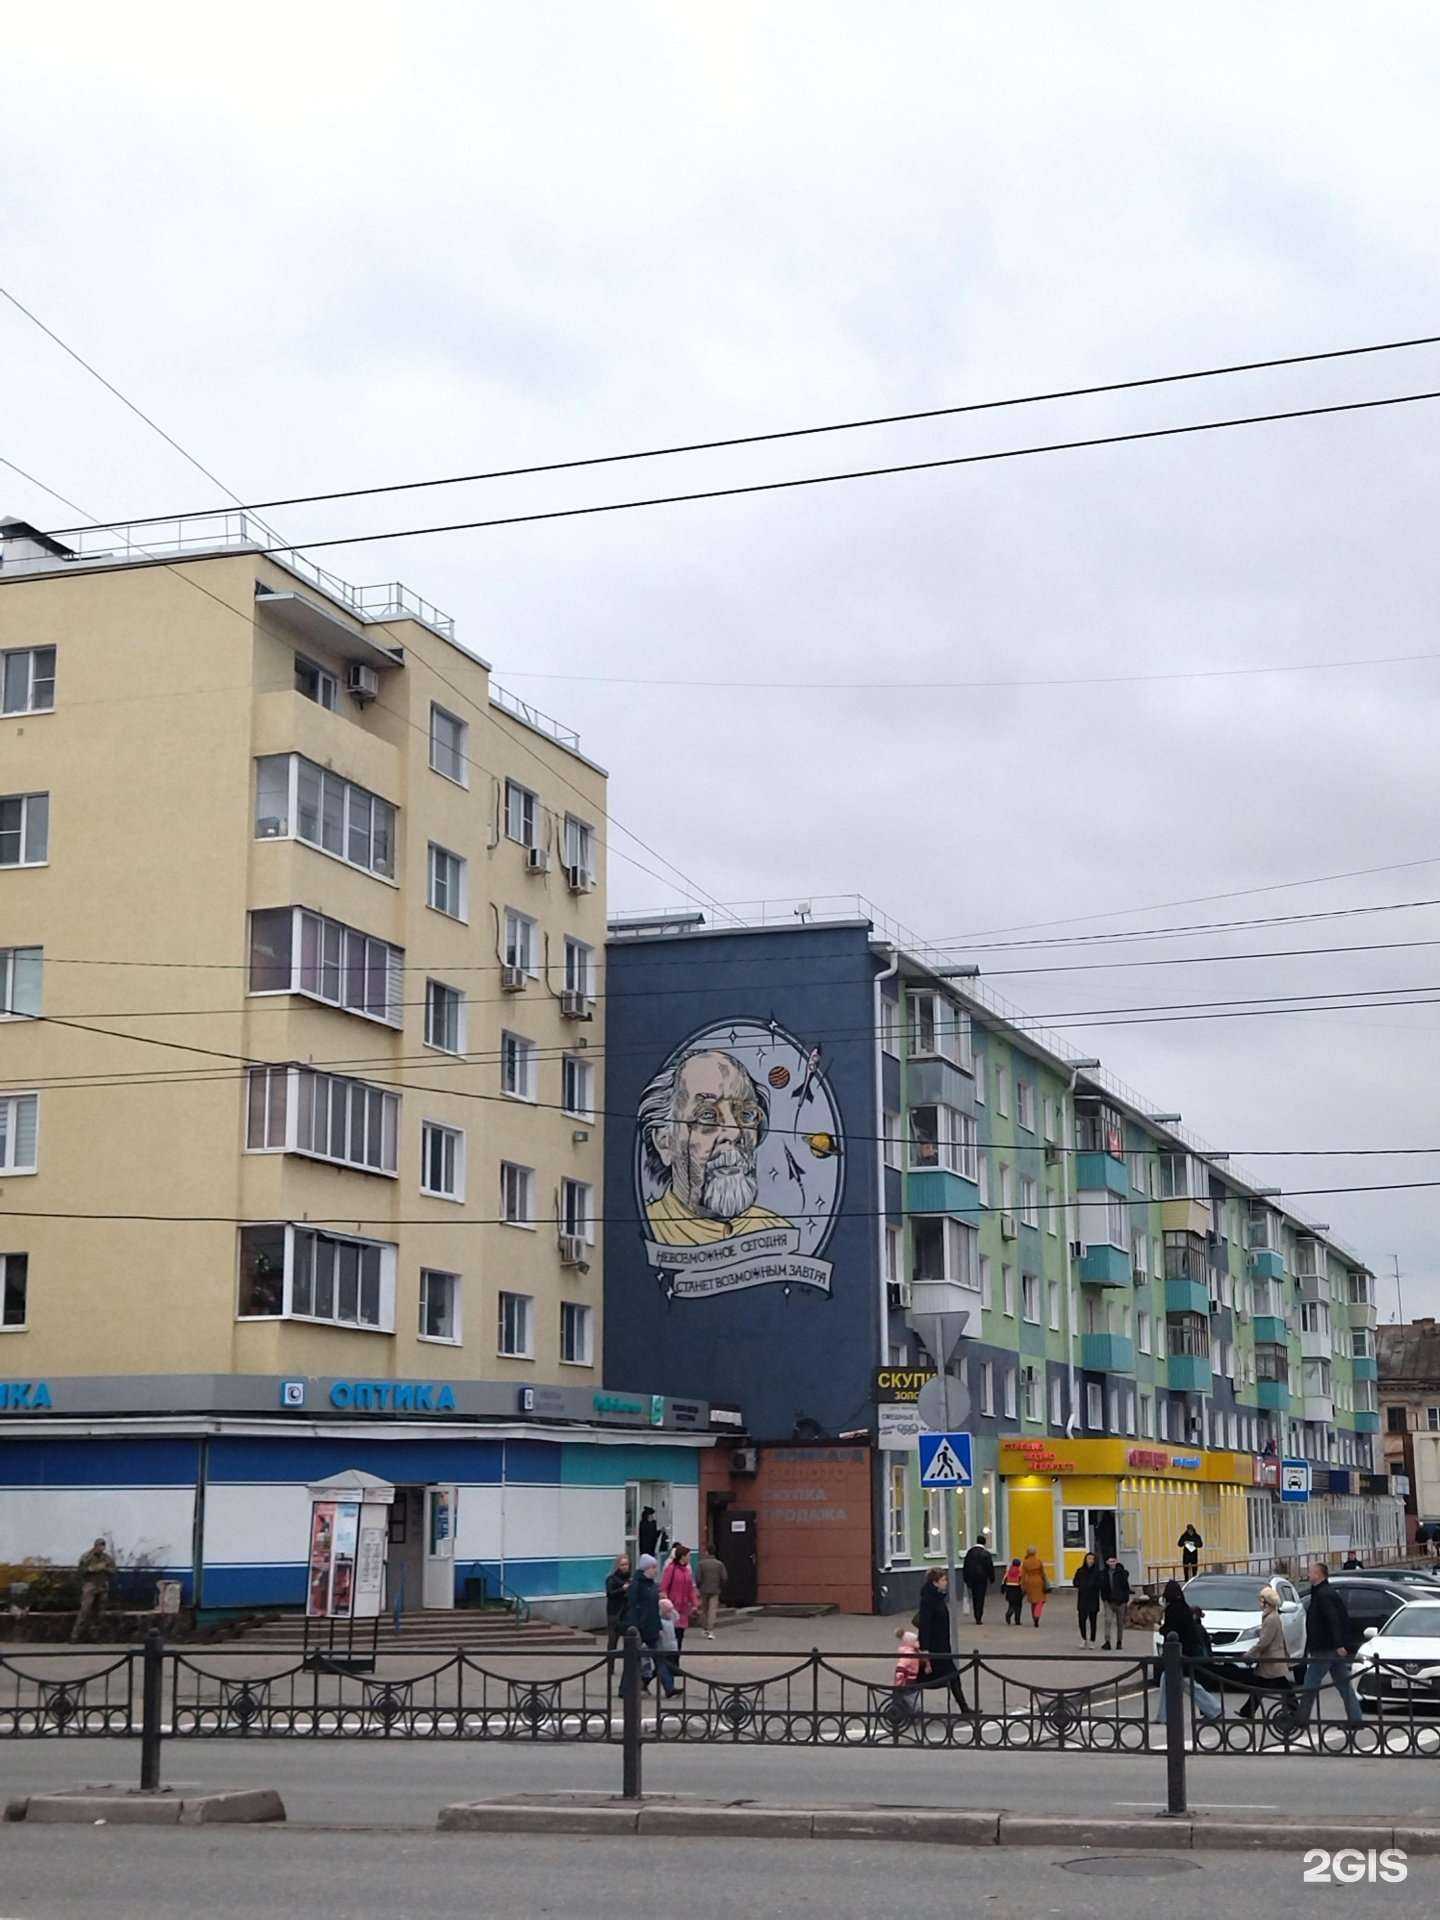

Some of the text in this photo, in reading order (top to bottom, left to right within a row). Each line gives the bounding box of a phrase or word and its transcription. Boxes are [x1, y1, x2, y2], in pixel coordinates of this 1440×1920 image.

[656, 1234, 788, 1264] НЕВОЗМОЖНОЕ СЕГОДНЯ
[676, 1265, 827, 1294] СТАНЕТ ВОЗМОЖНЫМ ЗАВТРА
[329, 1380, 456, 1411] ОПТИКА
